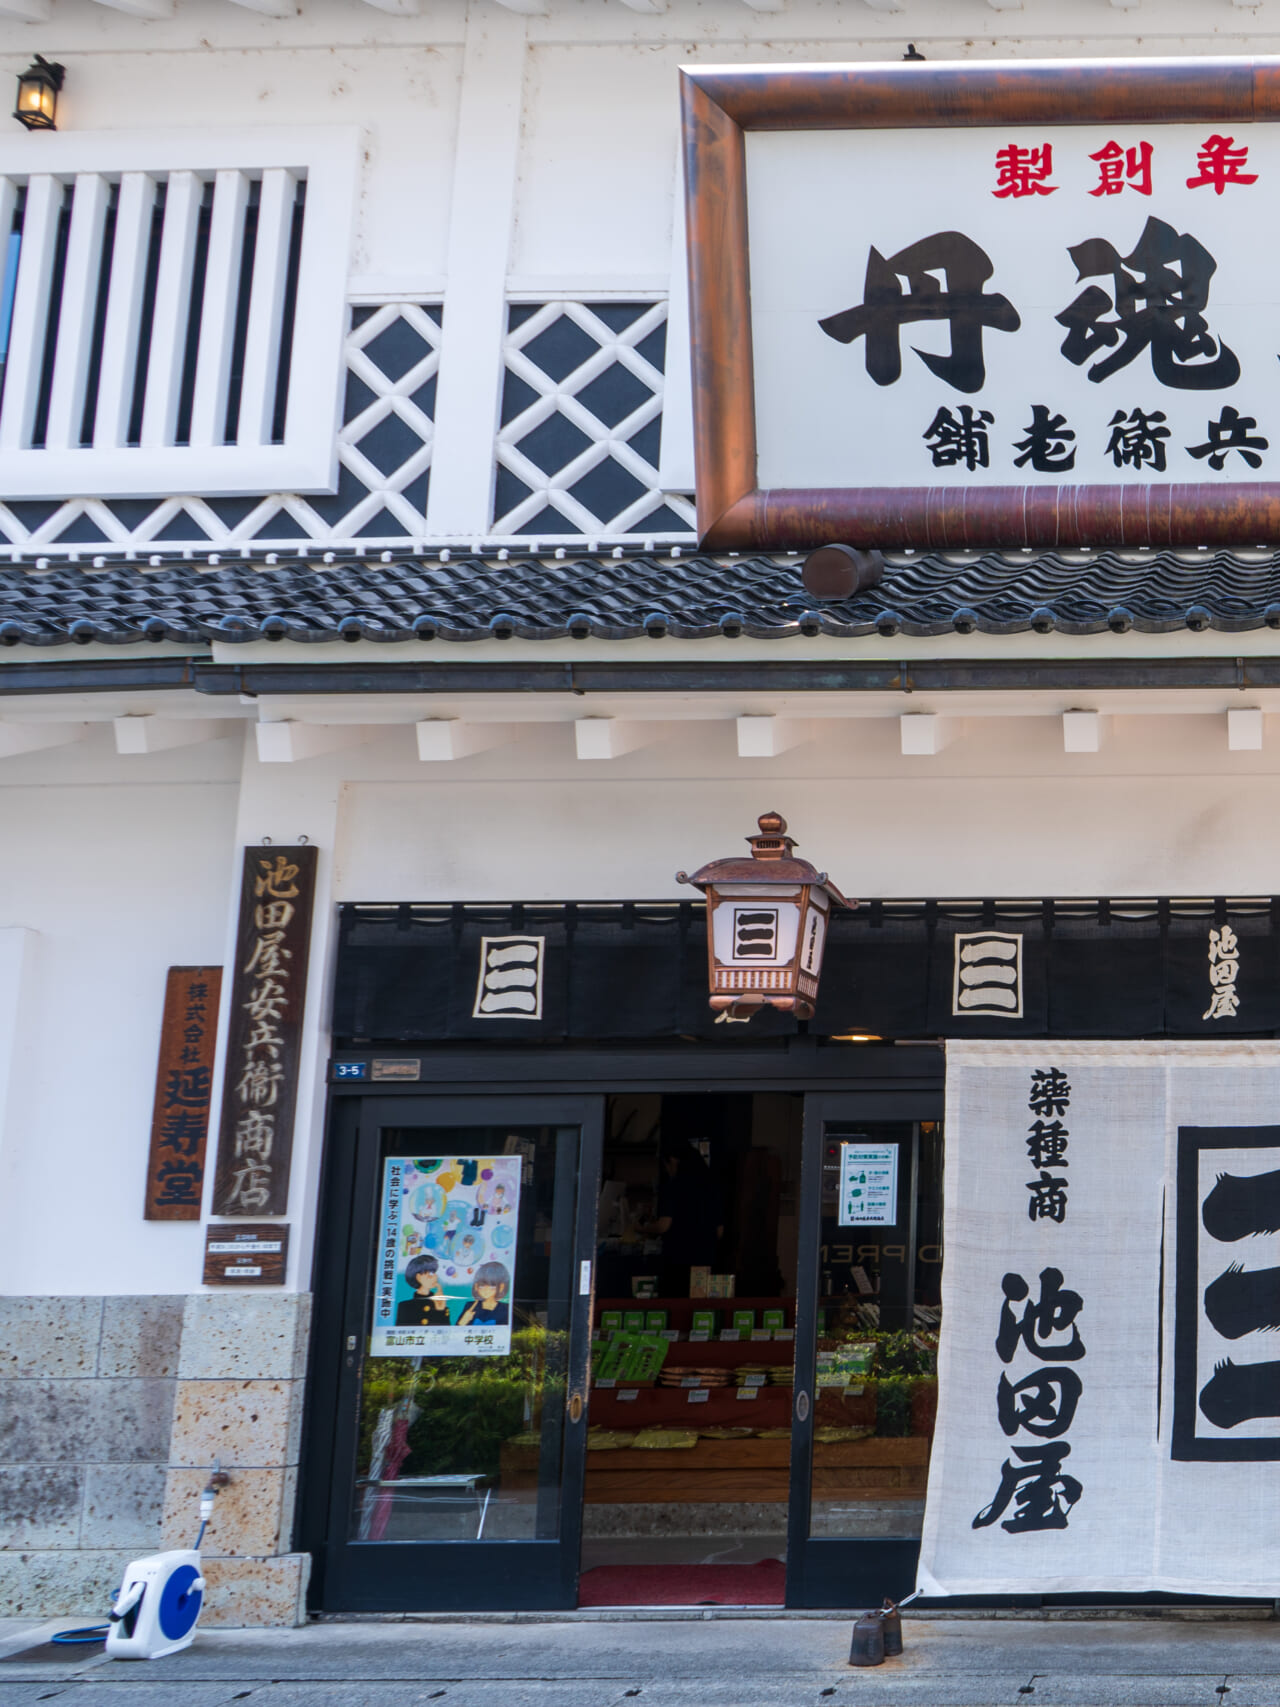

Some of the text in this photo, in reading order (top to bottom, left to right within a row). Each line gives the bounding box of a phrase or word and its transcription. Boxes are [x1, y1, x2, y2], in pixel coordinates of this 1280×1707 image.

[1203, 925, 1240, 1020] 池田屋
[339, 1066, 360, 1076] 3-5
[464, 1335, 494, 1345] 中学校
[971, 1267, 1087, 1534] 池田屋
